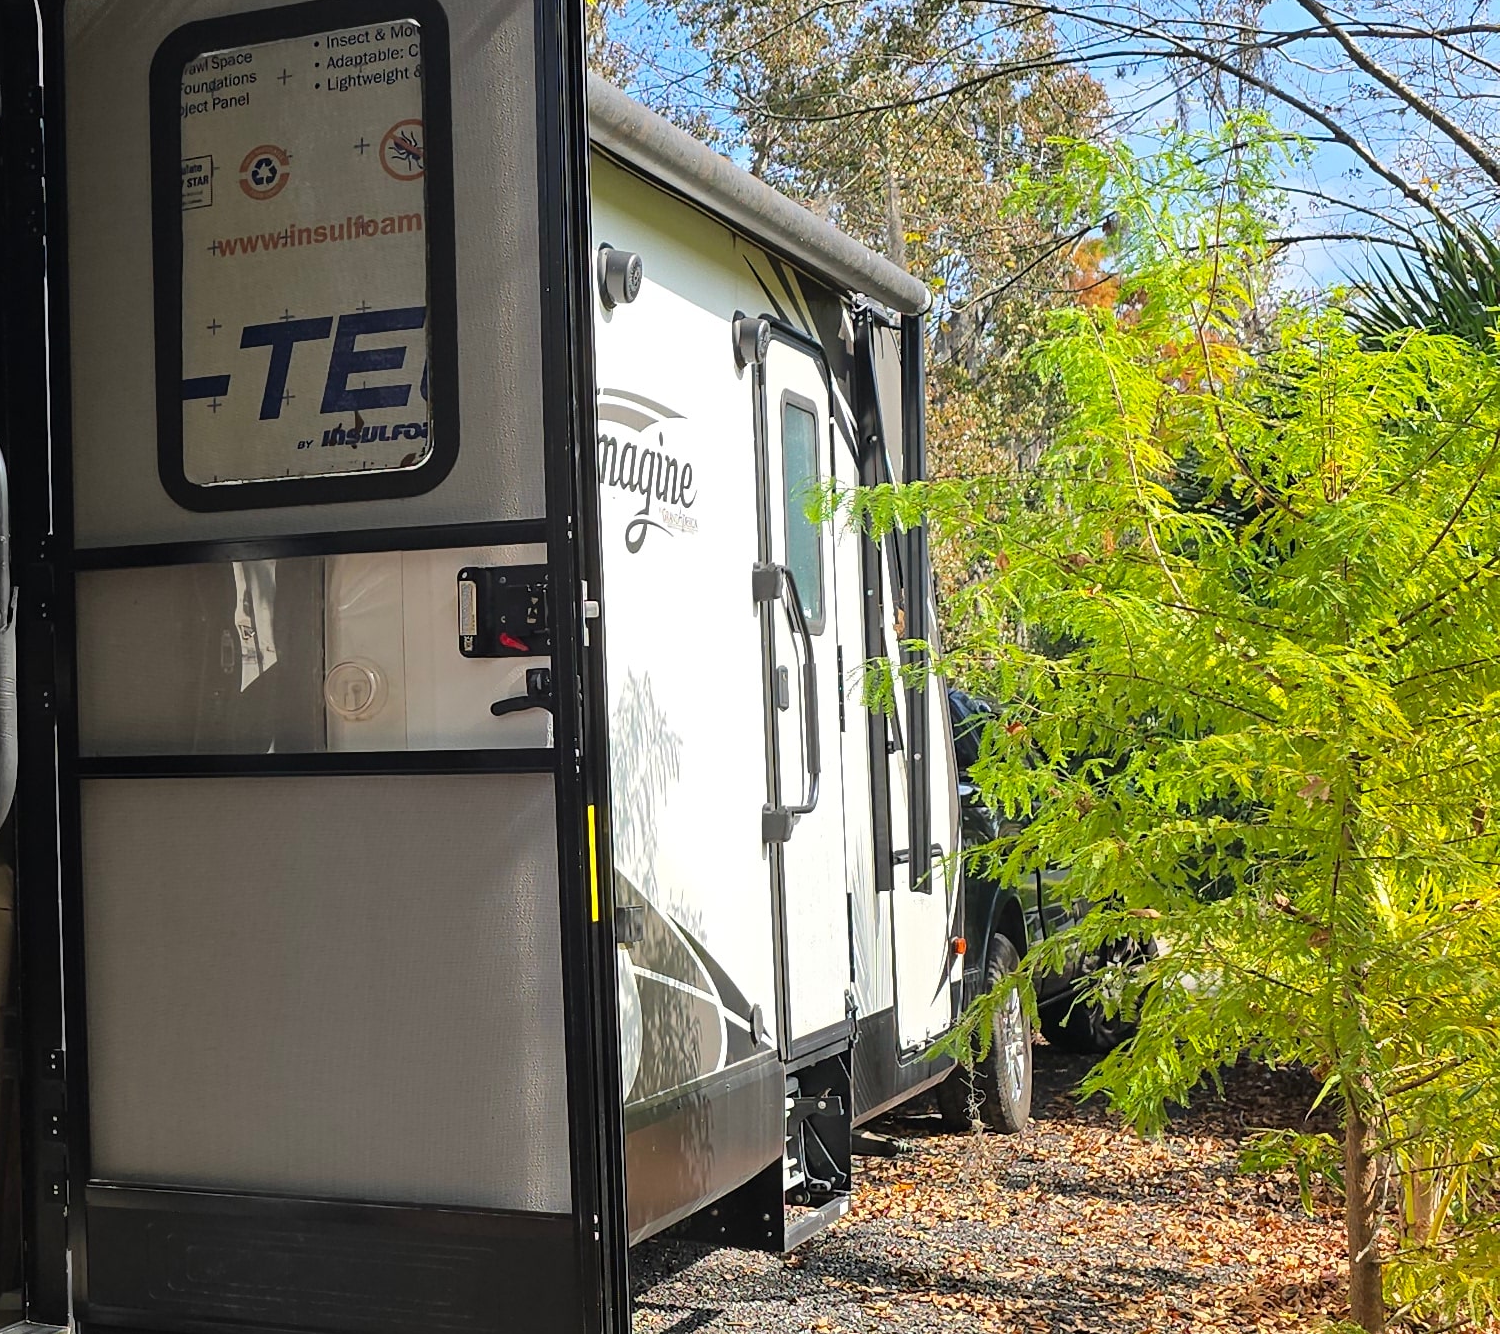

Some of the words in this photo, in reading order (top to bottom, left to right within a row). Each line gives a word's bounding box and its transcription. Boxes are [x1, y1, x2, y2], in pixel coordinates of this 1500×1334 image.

[326, 30, 370, 49] Insect
[375, 28, 386, 42] &
[391, 25, 420, 39] Mol
[211, 53, 253, 71] Space
[326, 47, 404, 70] Adaptable:
[408, 43, 420, 58] C
[327, 67, 409, 92] Lightweight
[212, 92, 250, 111] Panel
[187, 175, 209, 188] STAR
[218, 212, 423, 258] www.insulfoam
[182, 306, 427, 421] -TE
[297, 439, 314, 450] BY
